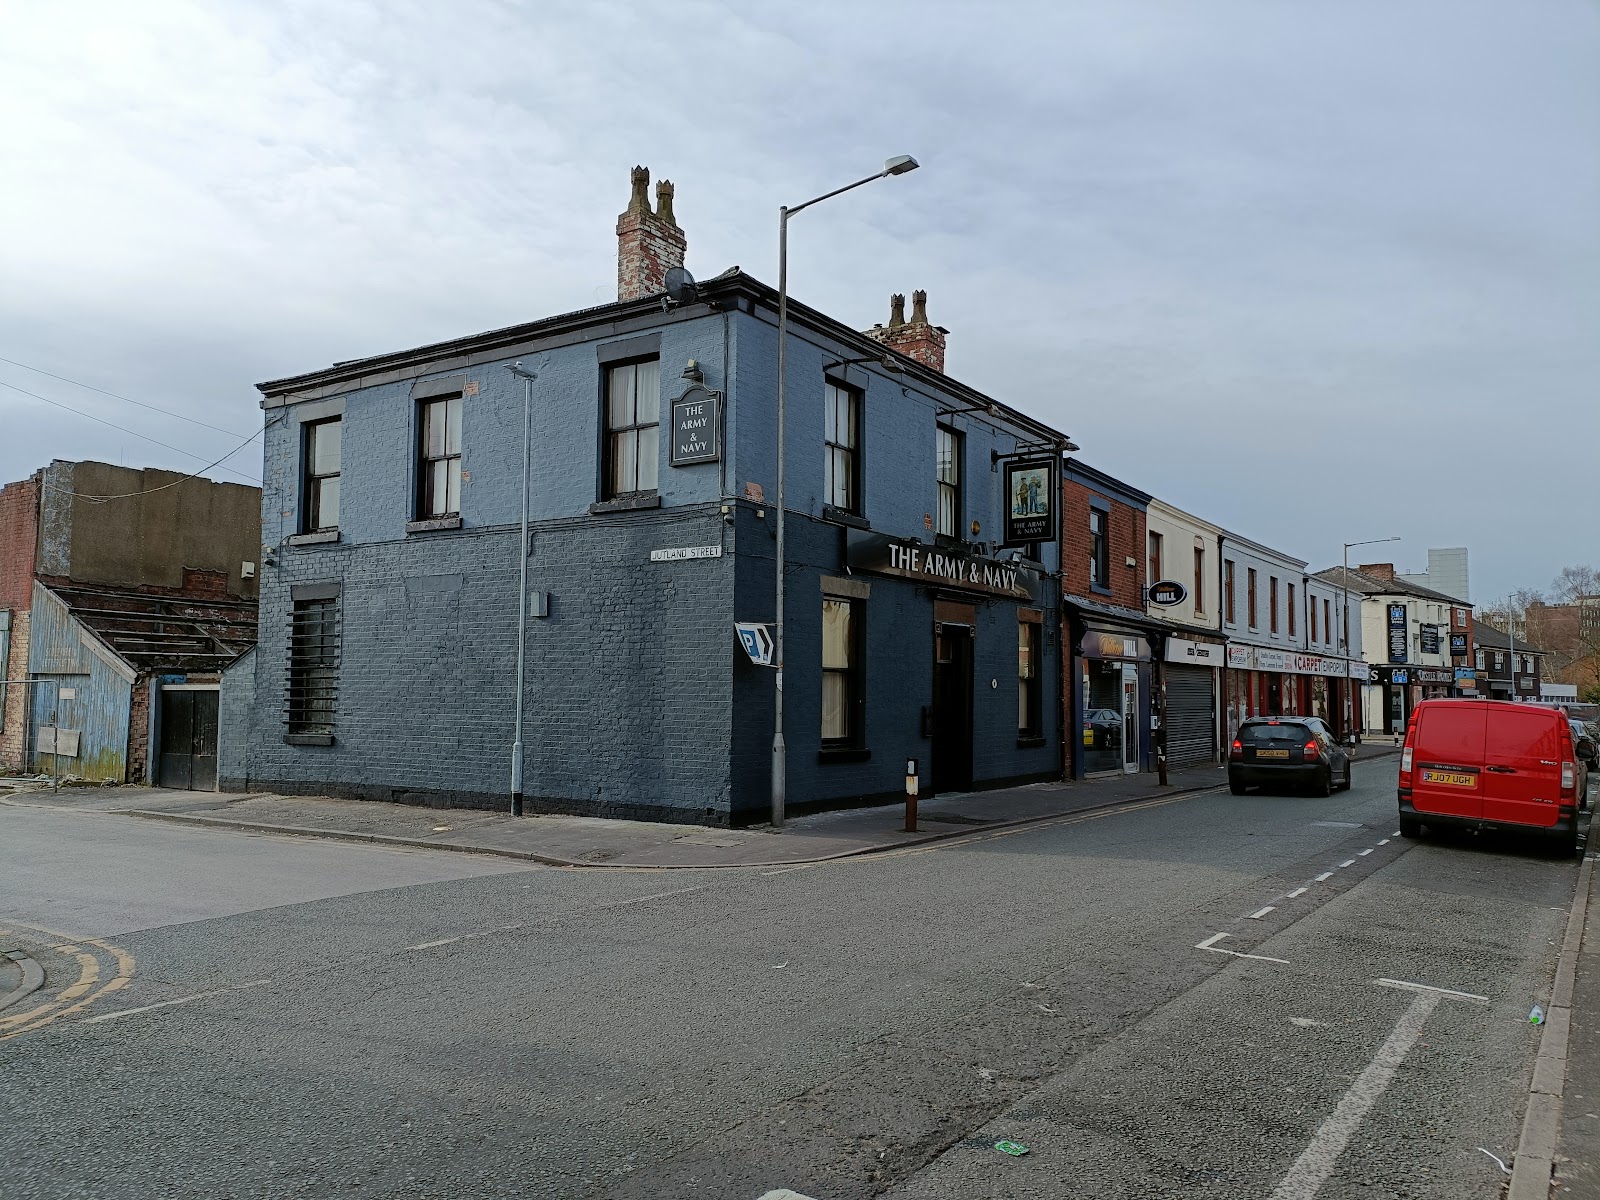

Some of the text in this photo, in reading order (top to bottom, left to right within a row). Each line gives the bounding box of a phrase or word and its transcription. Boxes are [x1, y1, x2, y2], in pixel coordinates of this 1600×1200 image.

[685, 405, 703, 417] THE
[680, 417, 708, 431] ARMY
[690, 432, 698, 442] &
[681, 441, 708, 454] NAVY
[1027, 520, 1047, 528] ARMY
[1024, 527, 1043, 535] NAVY
[652, 547, 720, 560] JUTLAND STREET
[888, 543, 1018, 592] THE ARMY & NAVY
[1156, 592, 1177, 602] HILL
[742, 633, 754, 654] P
[1123, 639, 1137, 657] HILL
[1298, 656, 1322, 672] CARPET
[1323, 660, 1347, 674] EMPORIUM
[1427, 772, 1471, 785] RJ07 UGH
